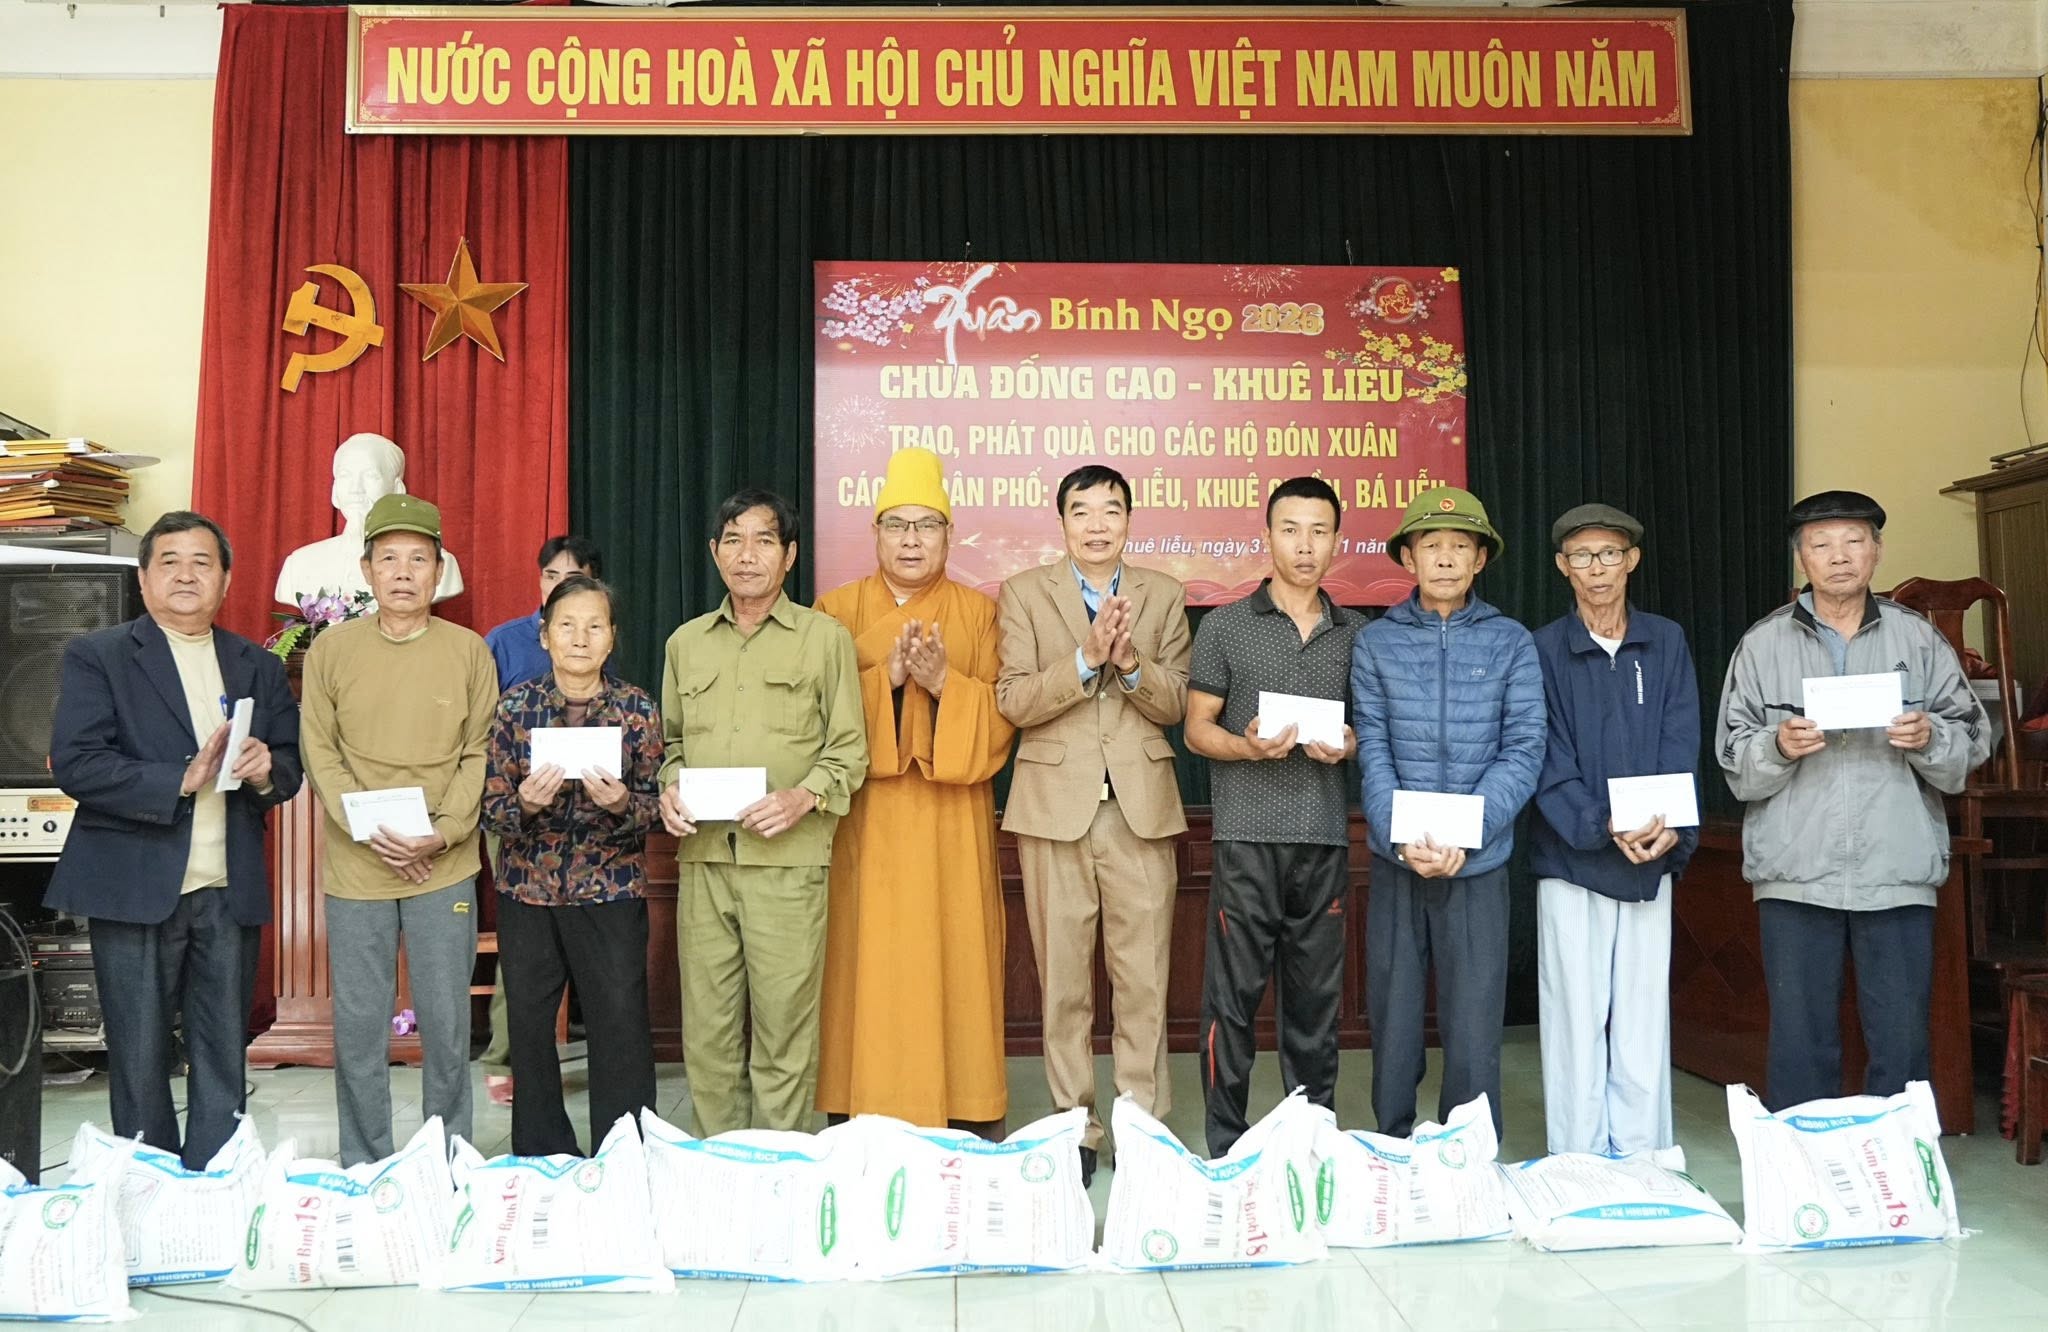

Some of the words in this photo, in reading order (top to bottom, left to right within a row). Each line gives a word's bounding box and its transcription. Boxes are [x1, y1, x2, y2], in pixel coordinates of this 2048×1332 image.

[387, 31, 511, 105] NƯỚC
[526, 36, 651, 118] CỘNG
[665, 36, 758, 107] HOÀ
[770, 37, 833, 107] XÃ
[845, 36, 920, 119] HỘI
[935, 24, 1025, 107] CHỦ
[1038, 37, 1178, 107] NGHĨA
[1188, 37, 1282, 119] VIỆT
[1295, 50, 1398, 107] NAM
[1411, 38, 1542, 108] MUÔN
[1555, 38, 1657, 108] NĂM
[1049, 297, 1141, 331] Bính
[1150, 298, 1233, 341] Ngọ
[1241, 301, 1326, 337] 2026
[879, 358, 980, 400] CHÙA
[1105, 366, 1177, 401] CAO
[1212, 361, 1313, 401] KHUÊ
[1322, 355, 1404, 402] LIỄU
[888, 424, 961, 459] TRAO,
[968, 420, 1036, 456] PHÁT
[1043, 420, 1097, 458] QUÀ
[1104, 425, 1156, 457] CHO
[1164, 421, 1216, 458] CÁC
[1224, 421, 1259, 463] HỘ
[1265, 421, 1320, 458] ĐÓN
[1327, 422, 1398, 458] XUÂN
[942, 470, 984, 507] ÂN
[992, 466, 1049, 508] PHỐ:
[1130, 467, 1189, 511] LIỄU,
[1196, 472, 1260, 508] KHUÊ
[1355, 472, 1388, 508] BÁ
[1123, 538, 1155, 553] huê
[1160, 535, 1196, 556] liễu,
[1202, 538, 1246, 558] ngày
[938, 1157, 963, 1182] 18
[501, 1174, 520, 1202] 18
[294, 1195, 321, 1222] 18
[1886, 1200, 1910, 1229] 18
[1246, 1232, 1269, 1257] 18
